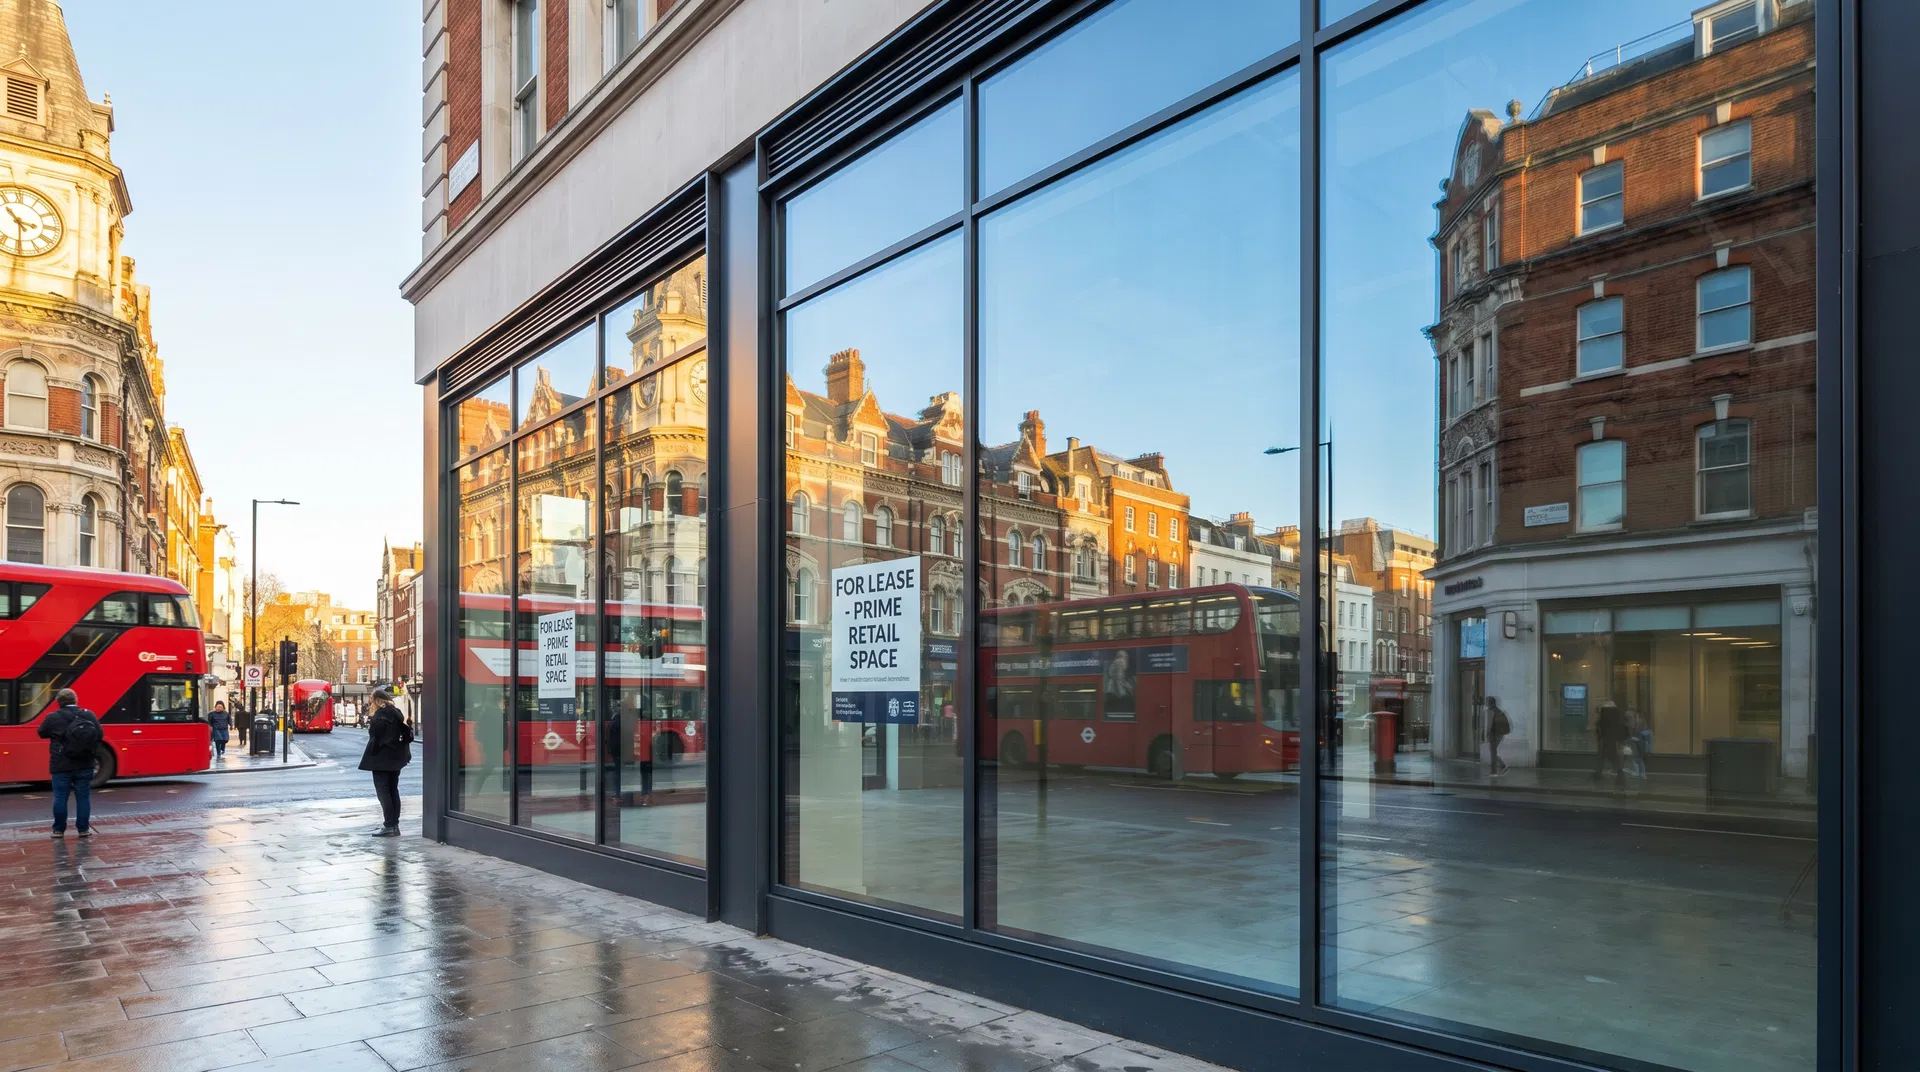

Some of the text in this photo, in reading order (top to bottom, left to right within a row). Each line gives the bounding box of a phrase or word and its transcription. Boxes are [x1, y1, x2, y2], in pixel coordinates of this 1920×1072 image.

[836, 568, 915, 597] FOR LEASE
[854, 597, 902, 620] PRIME
[540, 617, 573, 634] FOR LEASE
[849, 623, 900, 645] RETAIL
[547, 635, 569, 650] PRIME
[545, 652, 569, 667] RETAIL
[849, 648, 898, 669] SPACE
[545, 669, 567, 684] SPACE
